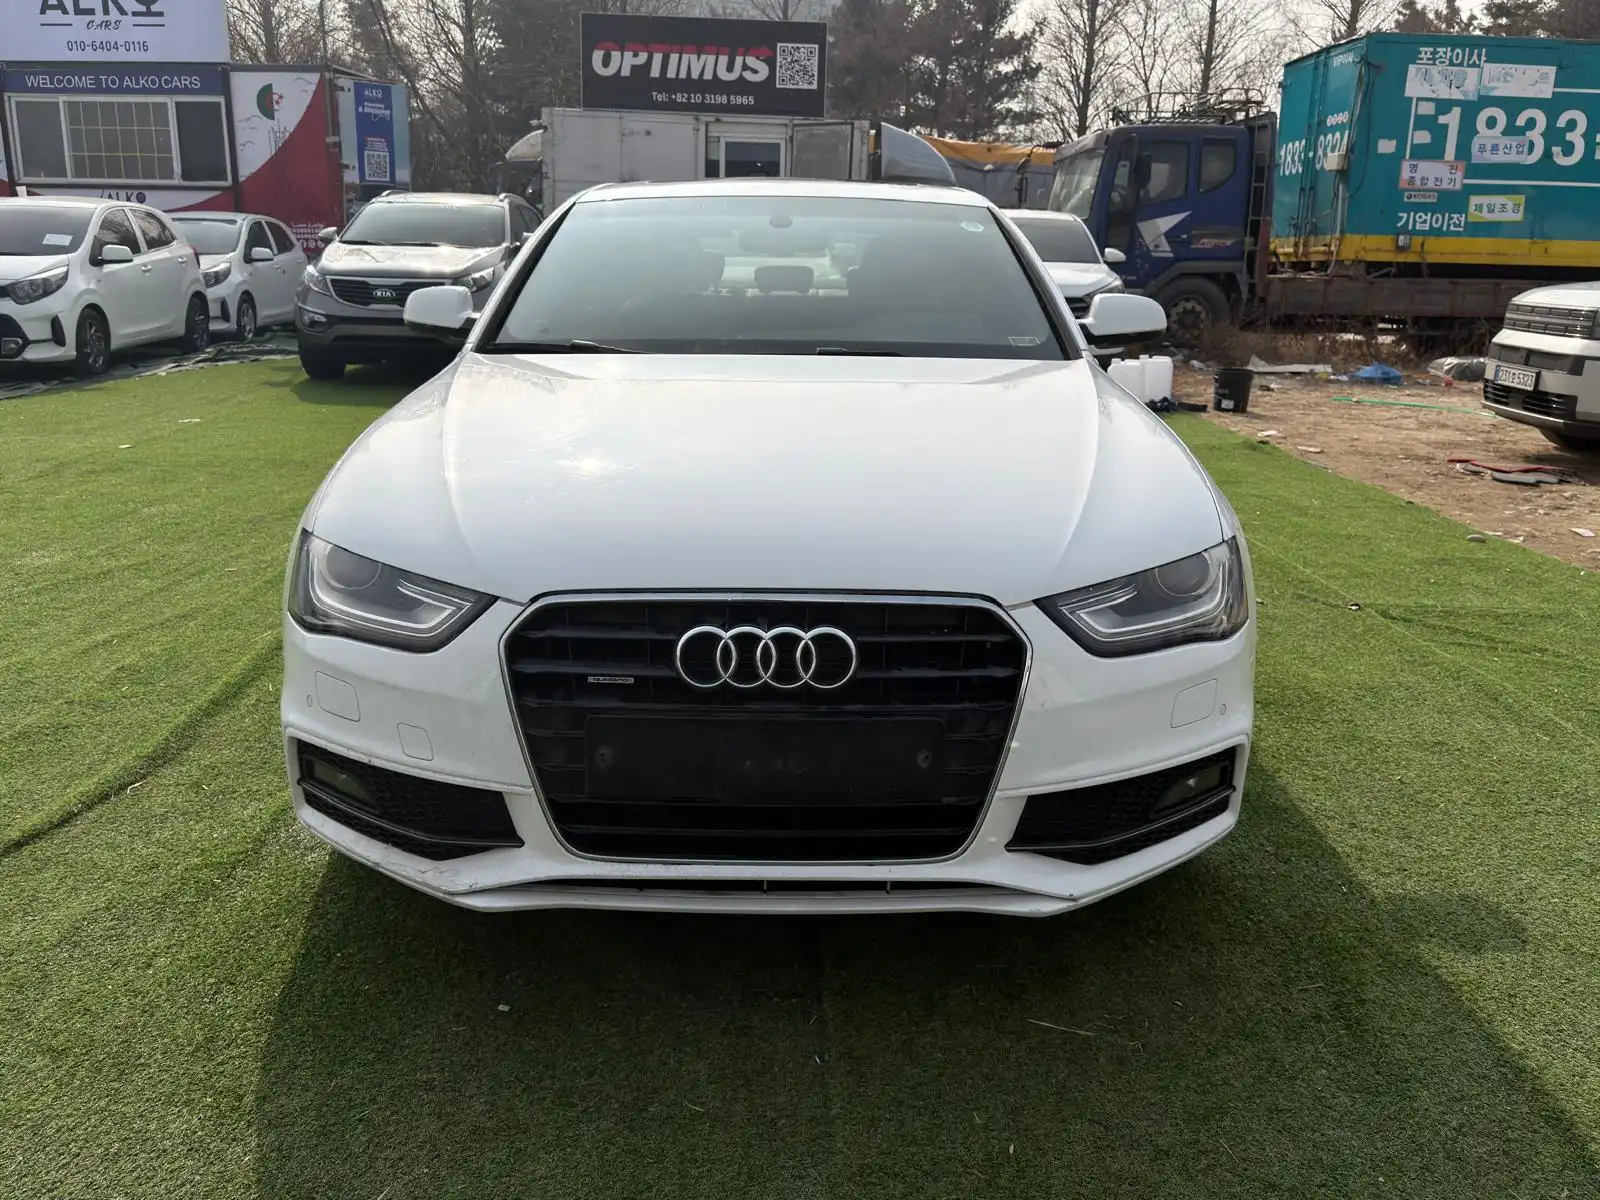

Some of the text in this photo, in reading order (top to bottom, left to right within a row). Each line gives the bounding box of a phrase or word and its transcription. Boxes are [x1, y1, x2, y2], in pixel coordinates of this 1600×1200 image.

[86, 19, 122, 31] CARS
[66, 40, 149, 52] 010-6404-0116
[591, 41, 774, 82] OPTIMUS
[1415, 47, 1487, 67] 포장이사
[25, 75, 201, 89] WELCOME TO ALKO CARS
[651, 91, 669, 102] Tel:
[671, 93, 688, 103] +82
[690, 93, 702, 103] 10
[1477, 143, 1525, 155] 푸른산업
[1396, 211, 1466, 231] 기업이전
